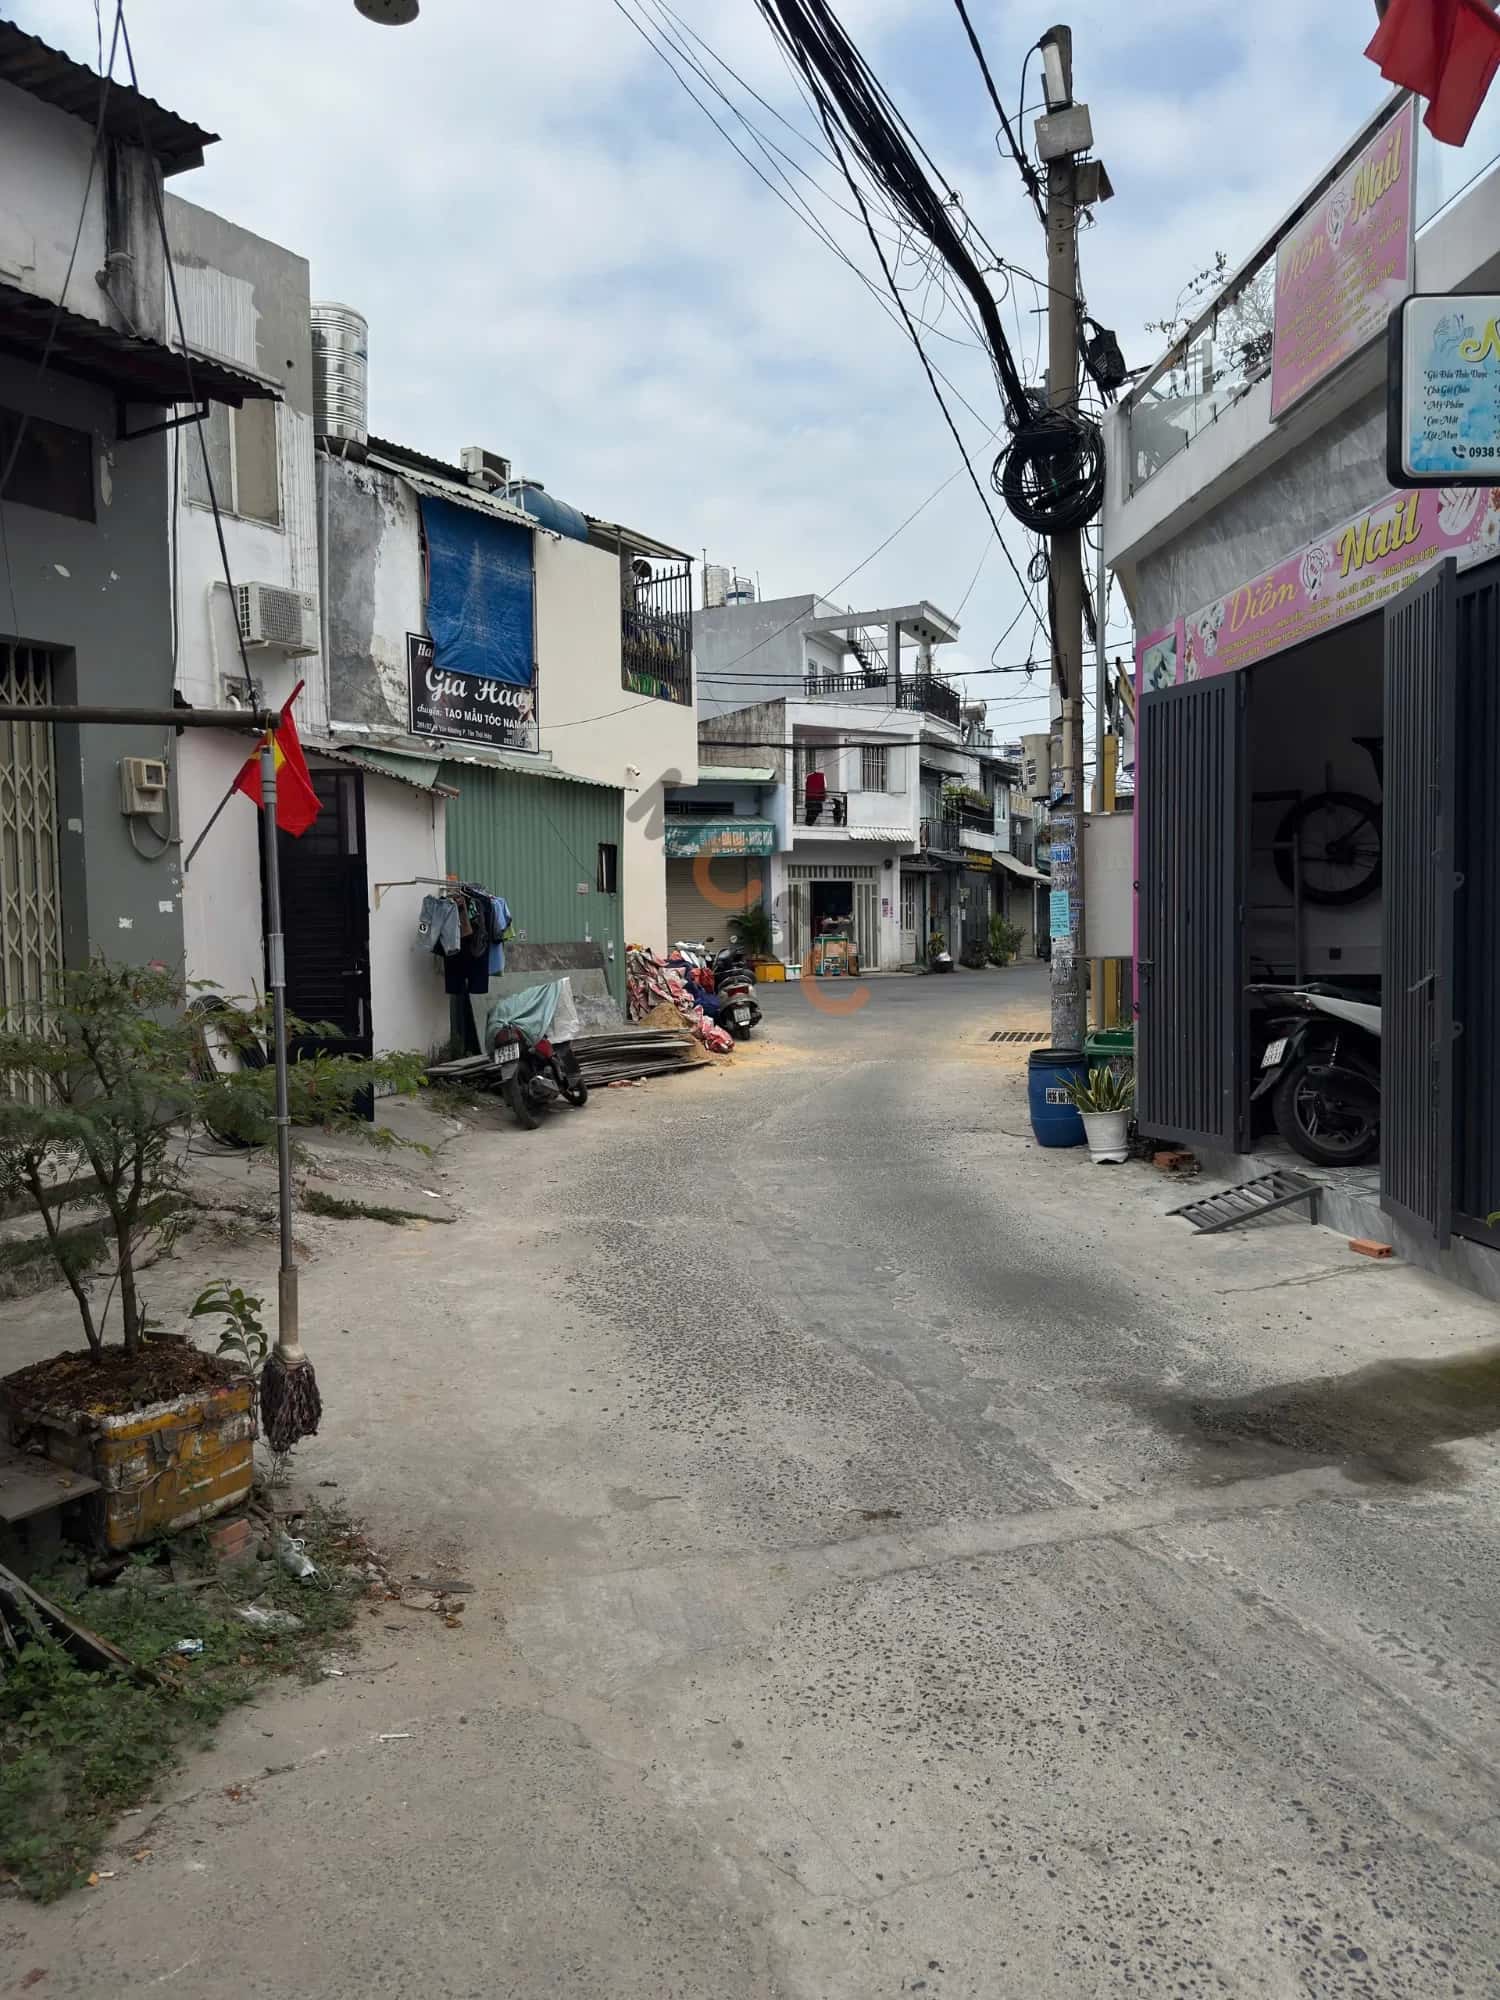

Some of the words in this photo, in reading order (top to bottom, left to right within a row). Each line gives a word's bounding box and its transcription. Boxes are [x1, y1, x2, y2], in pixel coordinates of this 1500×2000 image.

[1469, 446, 1494, 458] 0938
[1229, 576, 1297, 633] Diễm
[1337, 491, 1424, 578] Nail
[425, 667, 467, 701] Gia
[445, 707, 462, 721] TẠO
[484, 713, 502, 727] TÓC
